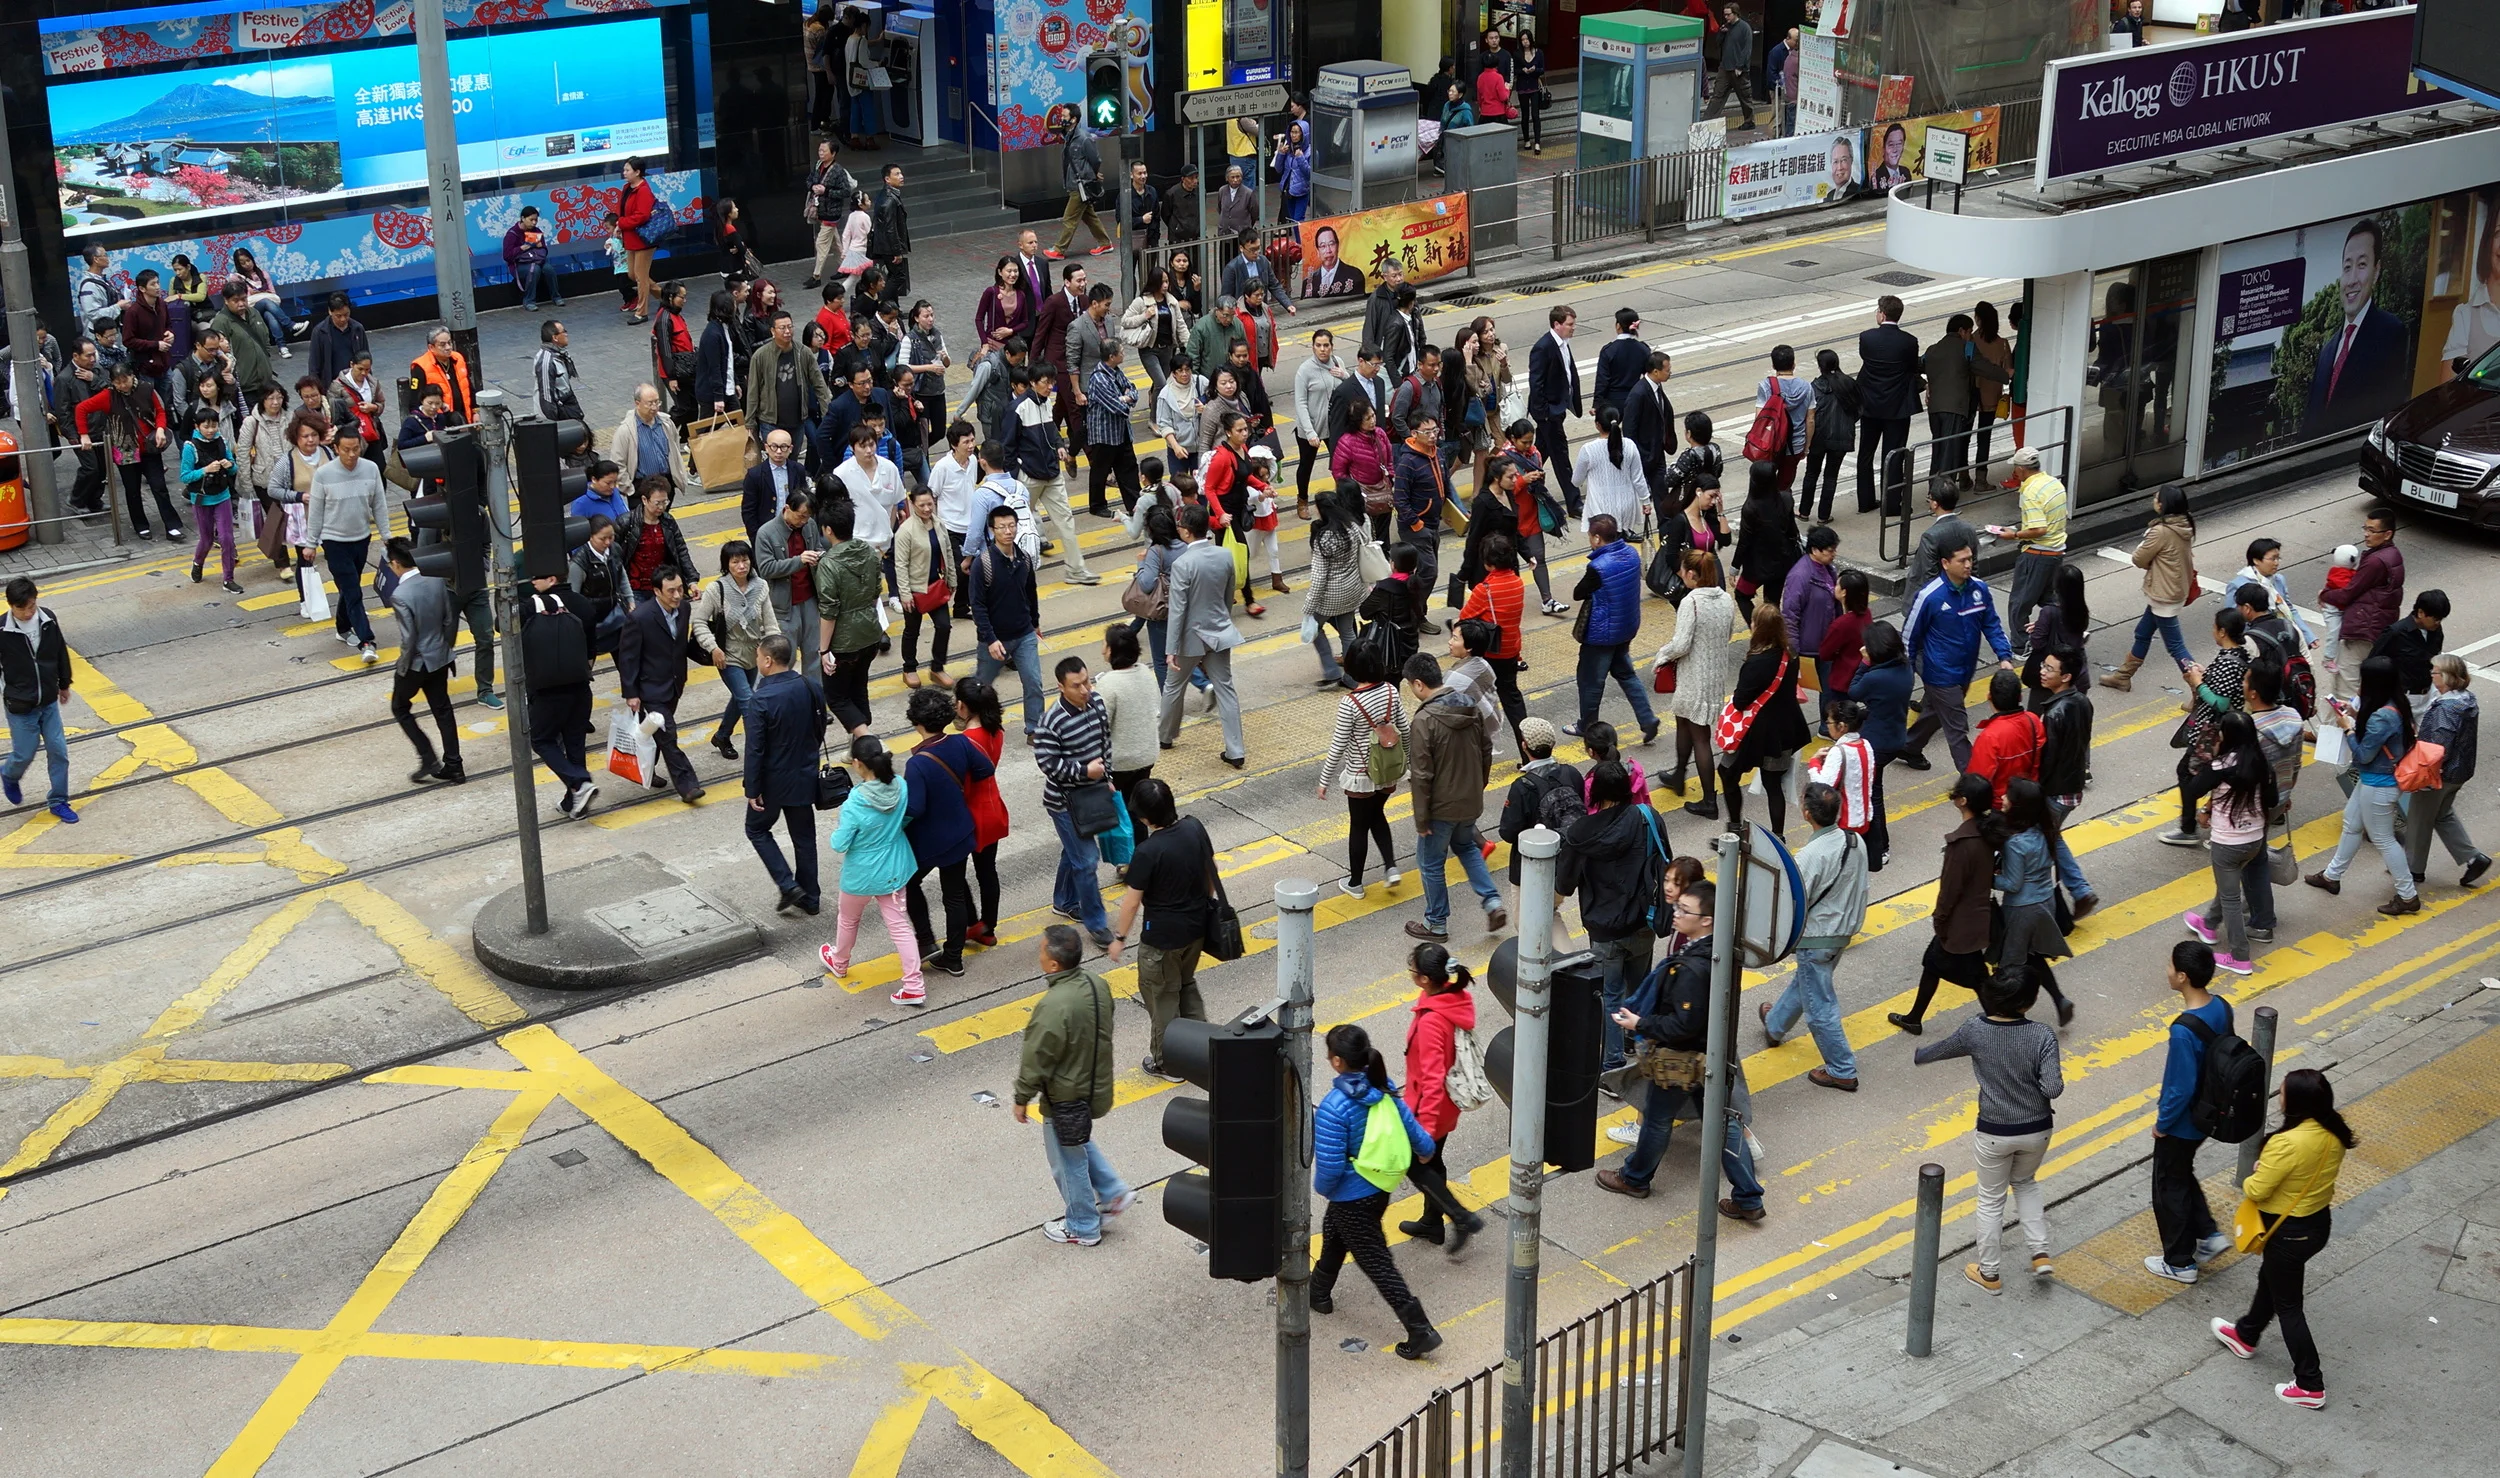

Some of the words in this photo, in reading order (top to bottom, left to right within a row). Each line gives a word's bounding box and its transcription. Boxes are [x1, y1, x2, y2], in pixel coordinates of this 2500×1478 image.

[242, 11, 299, 28] Festive
[375, 4, 407, 26] Festive
[385, 14, 407, 32] Love
[251, 28, 291, 44] Love
[50, 42, 99, 63] Festive
[1671, 42, 1696, 50] PAYPHONE
[63, 57, 97, 73] Love
[1245, 66, 1271, 75] CURRENCY
[2201, 47, 2306, 98] HKUST
[1246, 73, 1271, 81] EXCHANGE
[1327, 77, 1341, 85] PCCW
[355, 73, 490, 105] 全新獨家優惠
[1192, 97, 1207, 105] Des
[1209, 94, 1232, 103] Voeux
[1235, 91, 1253, 100] Road
[1255, 87, 1281, 97] Central
[2079, 75, 2162, 120] Kellogg
[1217, 102, 1258, 117] 德輔道中
[1391, 134, 1410, 143] PCCW
[2107, 132, 2161, 155] EXECUTIVE
[2162, 129, 2183, 144] MBA
[2186, 123, 2223, 140] GLOBAL
[2225, 111, 2271, 132] NETWORK
[1369, 231, 1467, 281] 恭賀新禧
[2241, 269, 2271, 287] TOKYO
[2239, 294, 2260, 305] Regional
[2260, 292, 2269, 300] Vice
[2269, 287, 2290, 297] President
[2238, 311, 2248, 319] Vice
[2248, 306, 2270, 317] President
[410, 377, 419, 390] 3
[2410, 484, 2425, 499] BL
